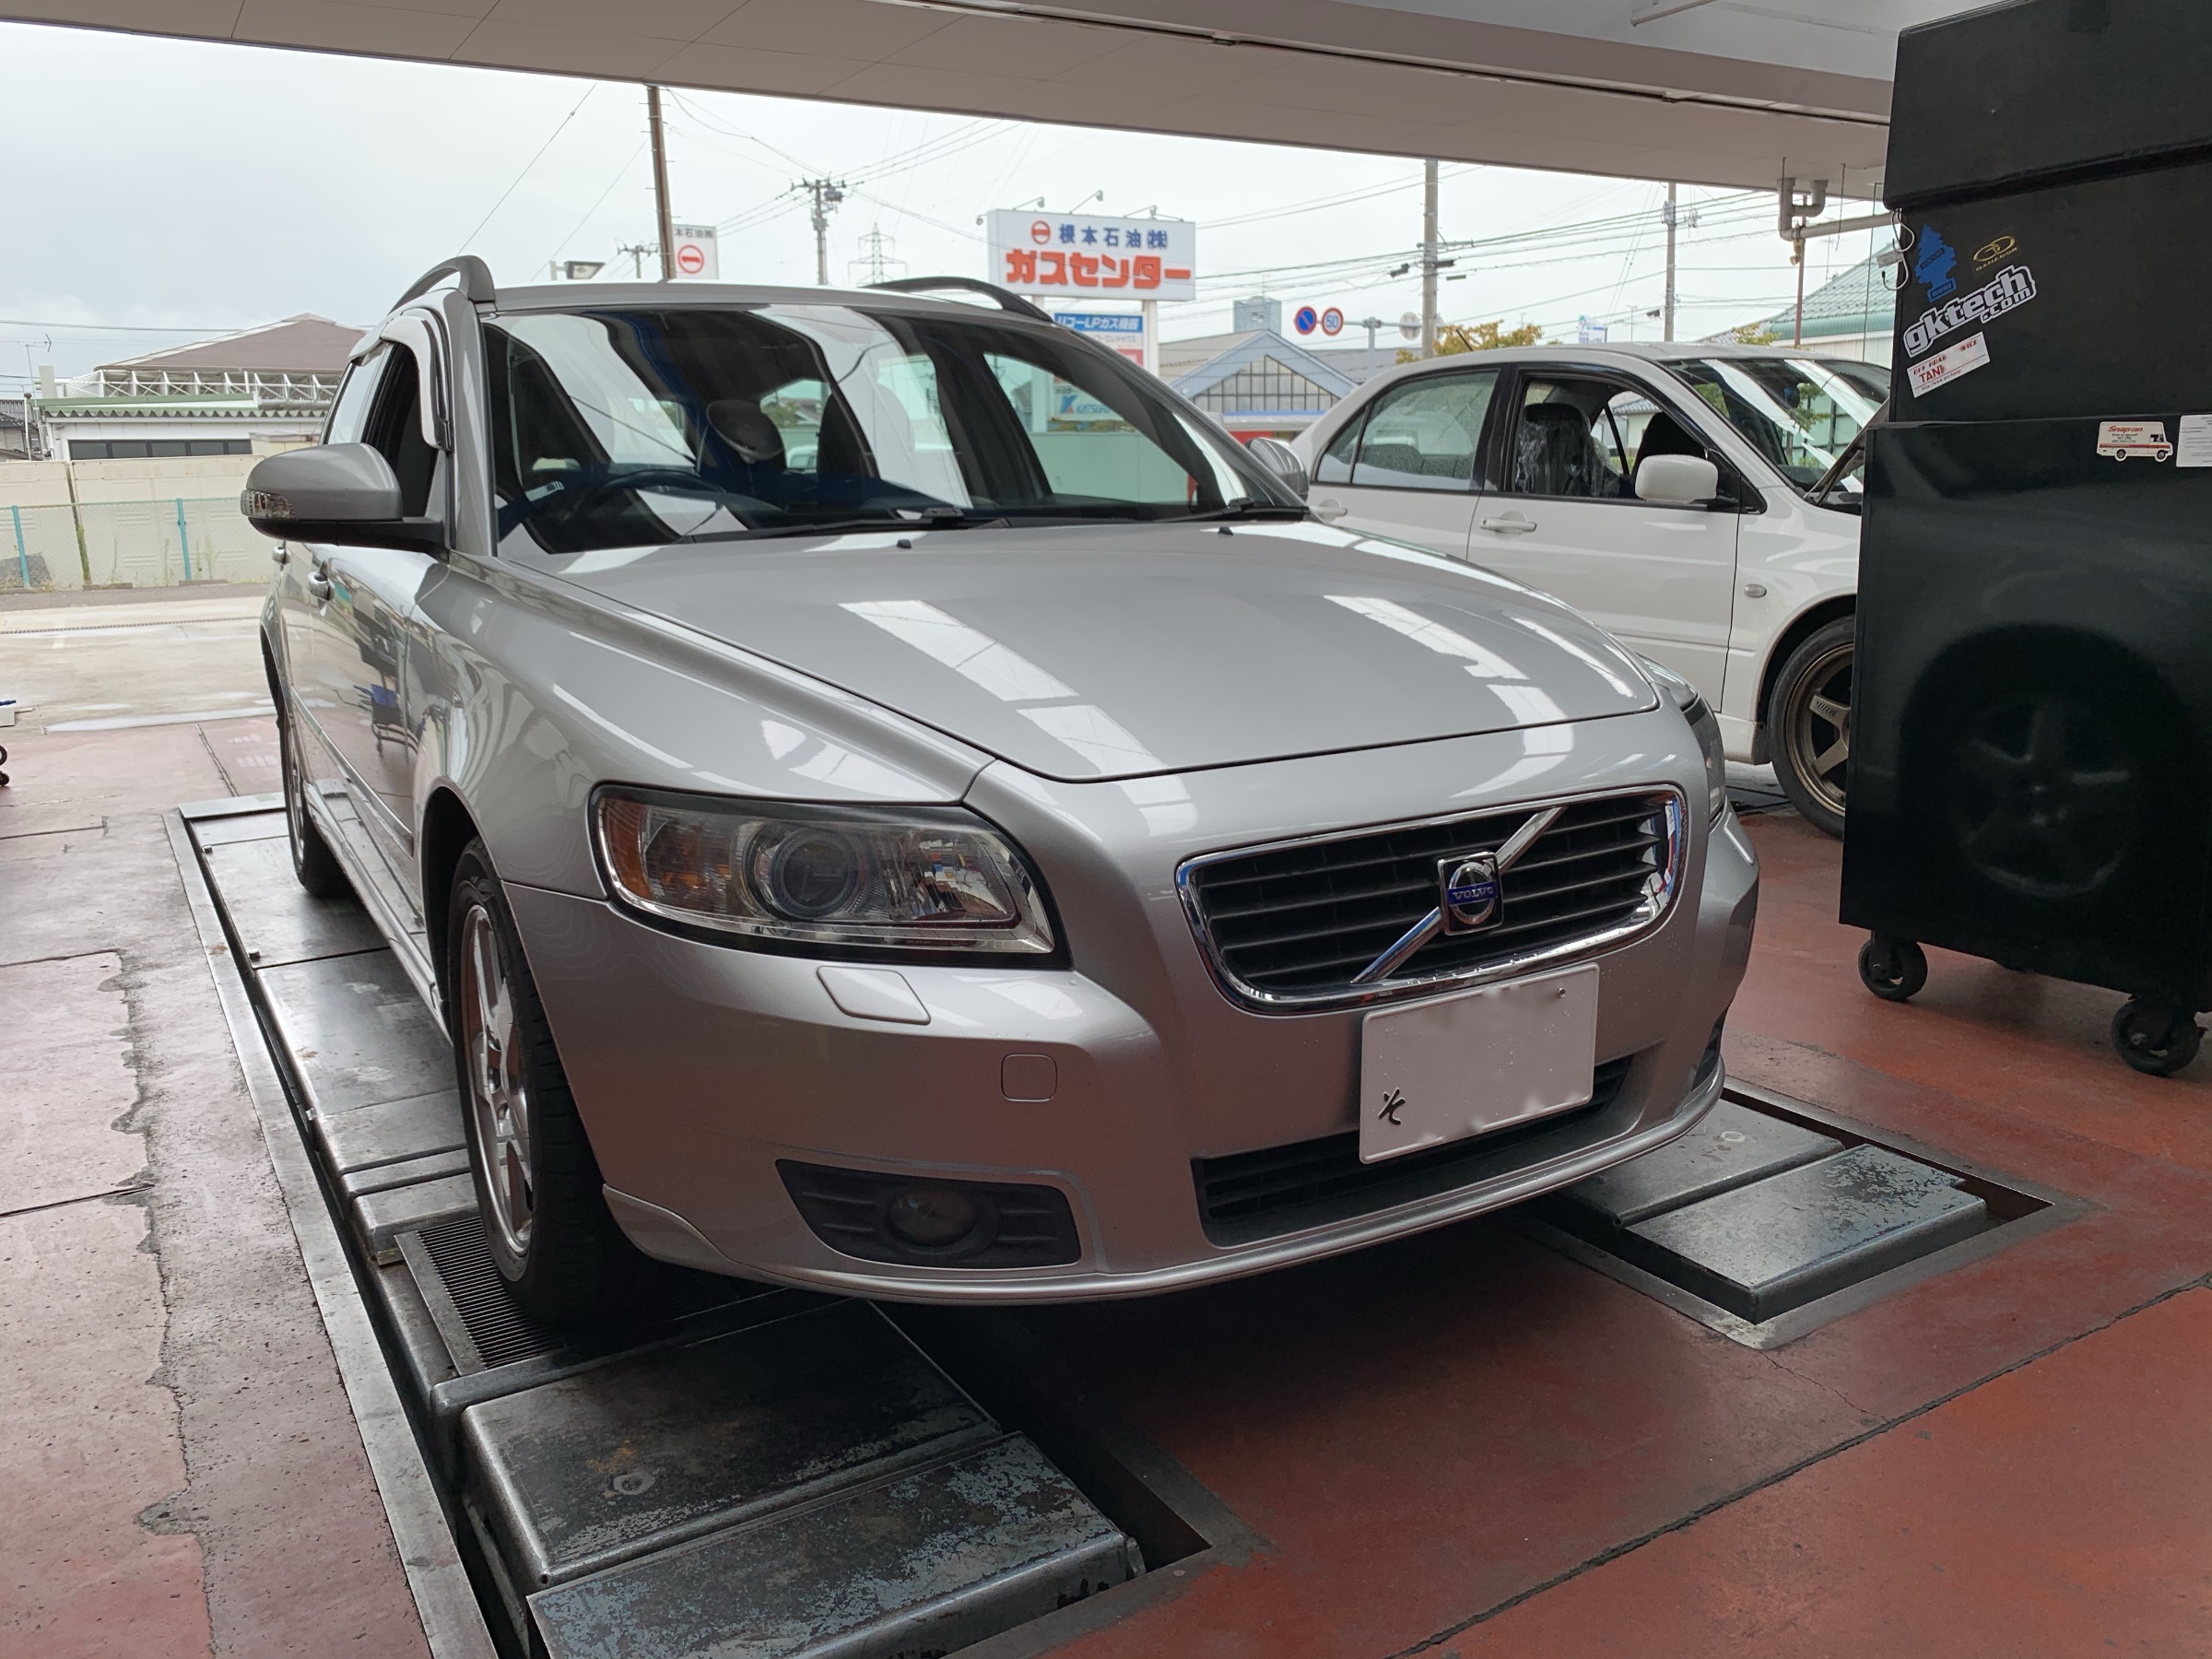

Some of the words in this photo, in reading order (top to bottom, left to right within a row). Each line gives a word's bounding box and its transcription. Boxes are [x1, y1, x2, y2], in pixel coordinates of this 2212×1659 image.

[1006, 249, 1191, 289] ガスセンター
[1325, 314, 1339, 329] 50
[1906, 271, 2029, 354] gktech
[1983, 288, 2032, 322] .com
[1453, 885, 1495, 901] VOLVO
